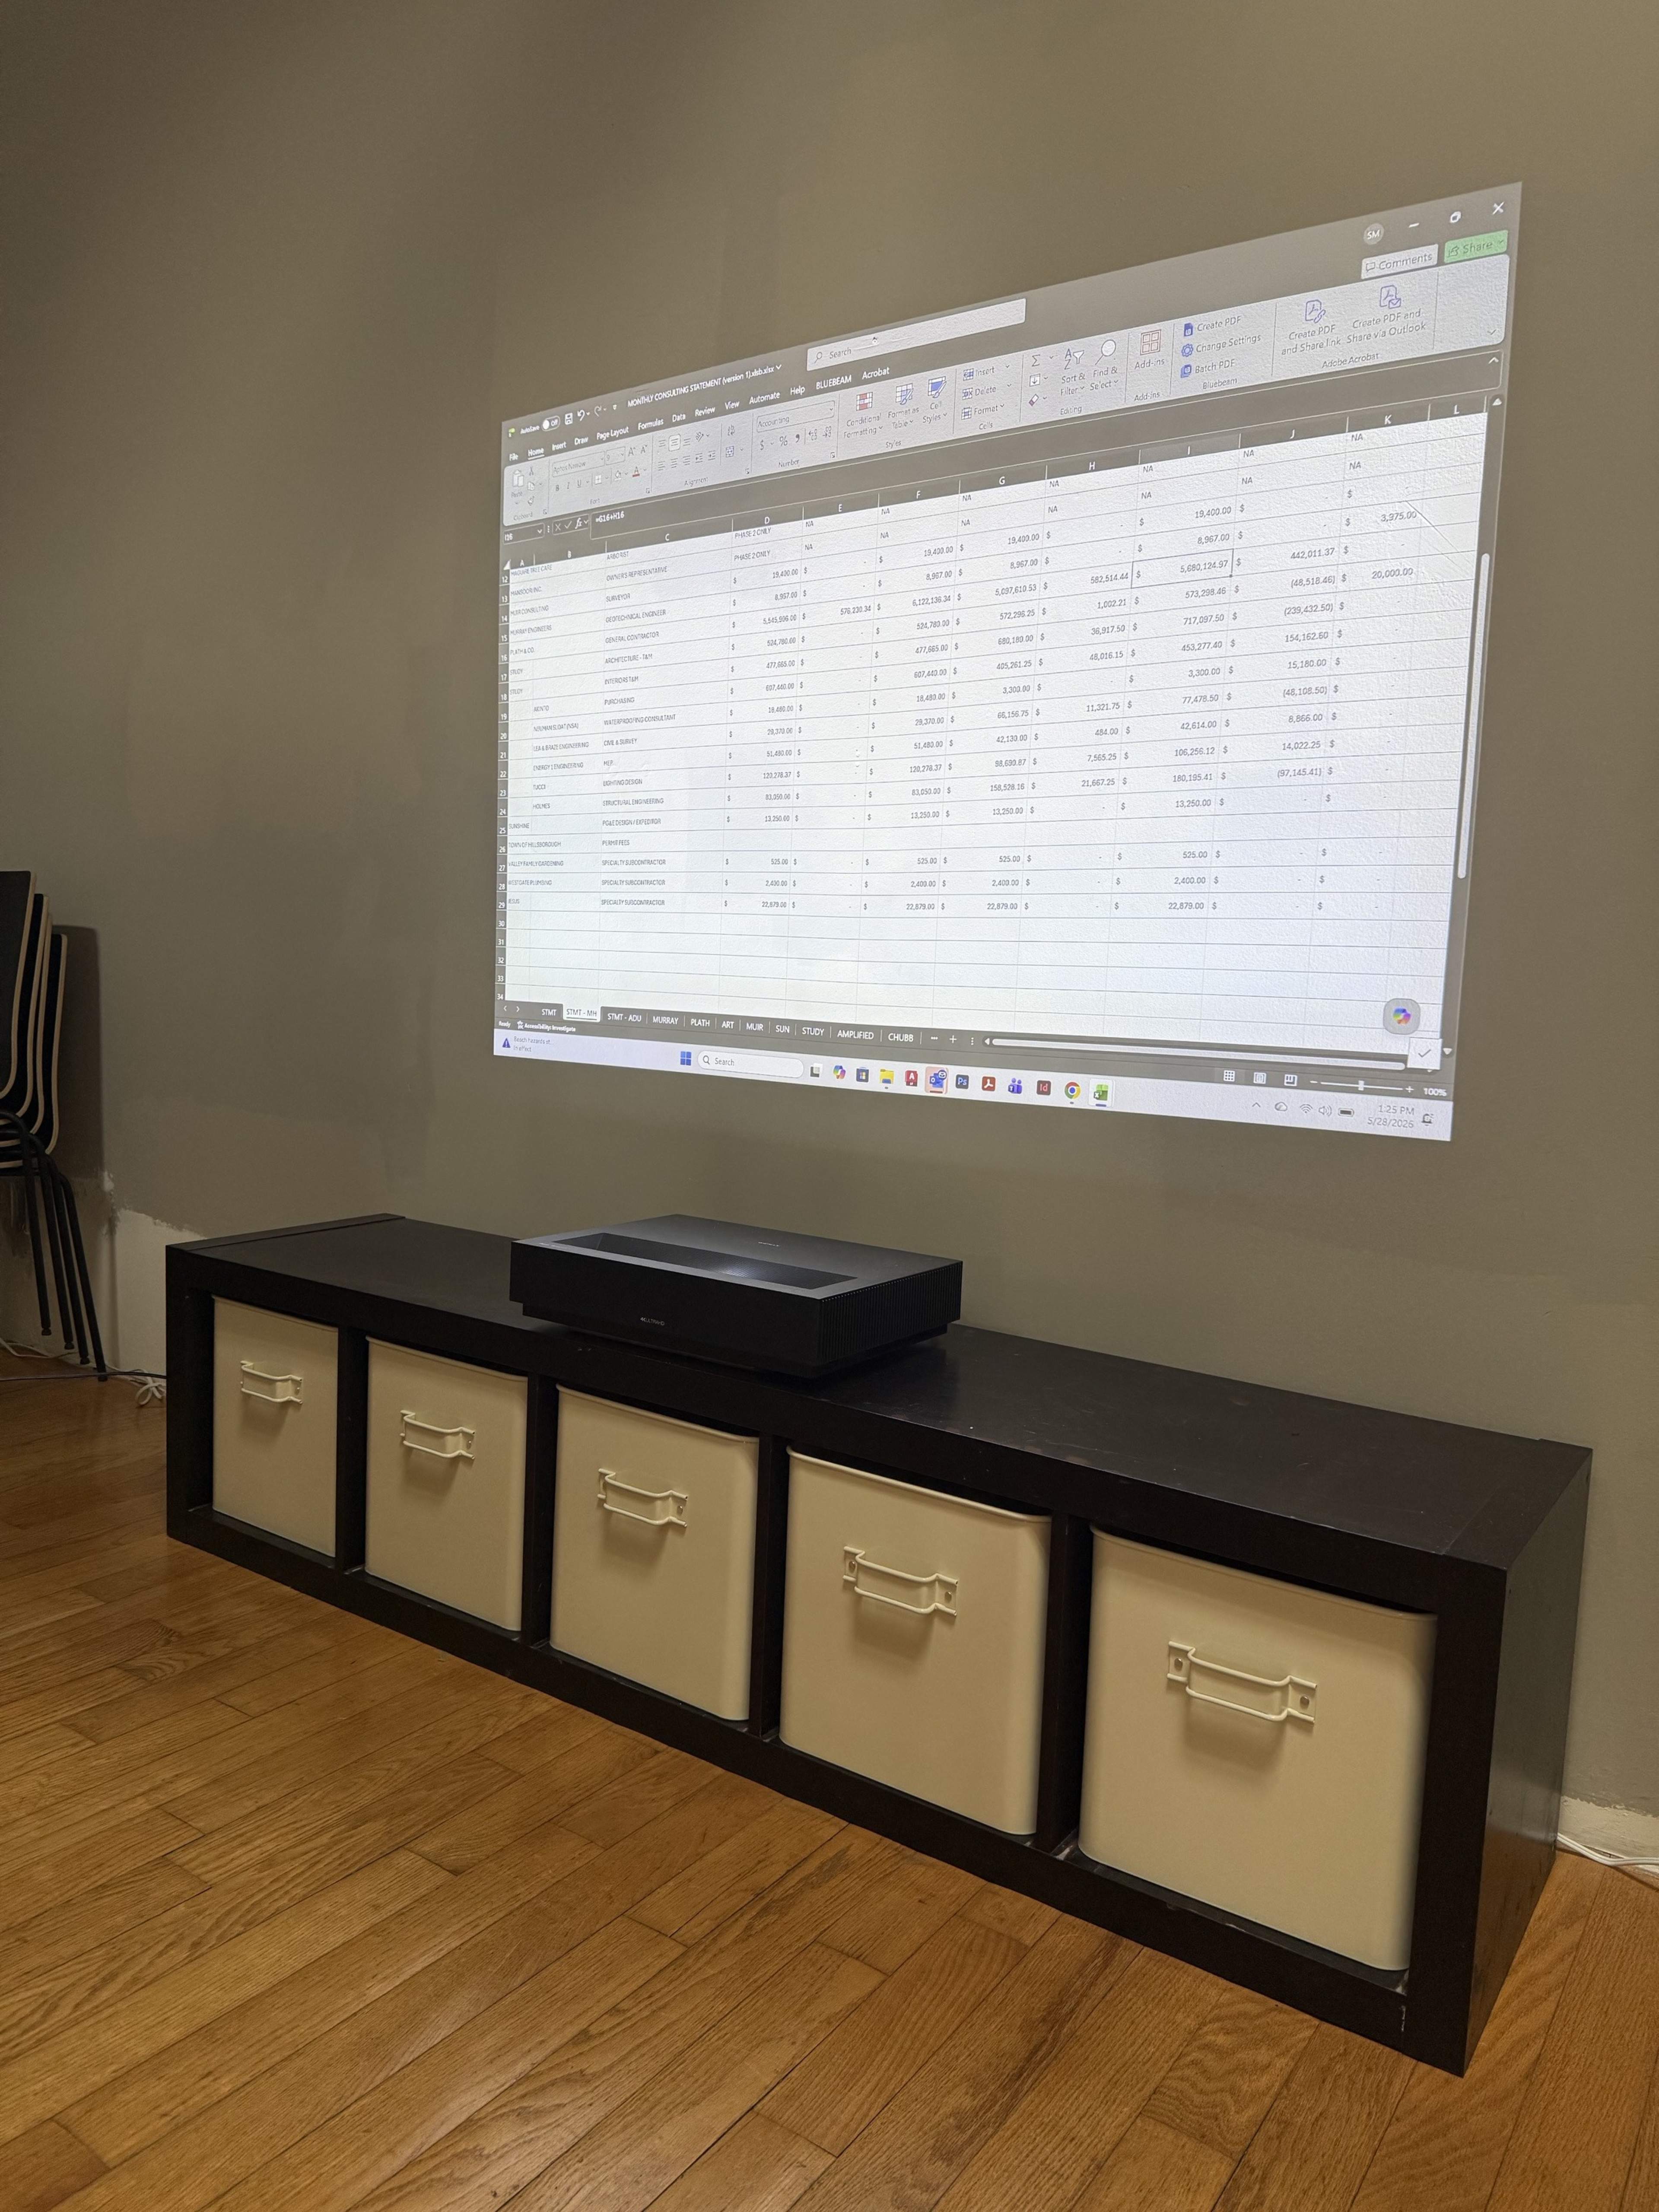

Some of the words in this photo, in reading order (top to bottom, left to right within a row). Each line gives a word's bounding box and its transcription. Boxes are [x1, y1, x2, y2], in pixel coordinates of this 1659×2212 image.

[1367, 230, 1380, 238] SM
[1463, 240, 1492, 253] Share
[1379, 253, 1433, 270] Comments
[1197, 320, 1222, 331] Create
[1225, 316, 1241, 326] PDF
[1352, 317, 1381, 329] Create
[1383, 313, 1401, 324] PDF
[1404, 309, 1421, 319] and
[1289, 327, 1316, 340] Create
[1318, 325, 1335, 335] PDF
[1347, 332, 1371, 344] Share
[1373, 330, 1386, 338] via
[1389, 322, 1426, 335] Outlook
[1196, 341, 1226, 353] Change
[1229, 334, 1261, 349] Settings
[1281, 346, 1297, 355] and
[1300, 342, 1324, 352] Share
[1326, 337, 1341, 347] link
[830, 348, 851, 359] Search
[1135, 358, 1164, 369] Add-ins
[1322, 358, 1347, 369] Adobe
[1348, 353, 1379, 365] Acrobat
[976, 367, 995, 376] Insert
[1195, 363, 1215, 374] Batch
[1217, 359, 1235, 369] PDF
[862, 367, 890, 379] Acrobat
[1093, 369, 1109, 377] Find
[817, 375, 852, 389] BLUEBEAM
[1062, 375, 1077, 384] Sort
[1203, 377, 1237, 389] Bluebeam
[628, 394, 653, 407] MONTHLY
[655, 385, 689, 401] CONSULTING
[690, 378, 721, 392] STATEMENT
[723, 372, 744, 386] (version
[791, 386, 805, 395] Help
[1090, 380, 1111, 391] Select
[975, 386, 996, 396] Delete
[1061, 386, 1078, 396] Filter
[1135, 391, 1160, 401] Add-ins
[749, 391, 780, 405] Automate
[725, 400, 739, 410] View
[974, 404, 998, 415] Format
[1060, 405, 1082, 415] Editing
[695, 406, 715, 416] Review
[888, 409, 910, 418] Format
[673, 413, 686, 422] Data
[758, 416, 789, 427] Accounting
[847, 414, 881, 426] Conditional
[923, 413, 941, 423] Styles
[638, 418, 663, 430] Formulas
[892, 420, 907, 428] Table
[521, 426, 539, 434] AutoSave
[597, 431, 610, 441] Page
[610, 426, 629, 437] Layout
[844, 427, 877, 439] Formatting
[552, 441, 566, 450] Insert
[575, 436, 588, 445] Draw
[886, 440, 901, 448] Styles
[779, 459, 799, 467] Number
[1350, 461, 1361, 470] NA
[595, 511, 624, 522] =G16+H16
[1195, 506, 1231, 519] 19,400.00
[1008, 534, 1039, 545] 19,400.00
[1198, 534, 1230, 545] 8,967.00
[1291, 547, 1335, 559] 442,011.37
[1010, 559, 1038, 570] 8,967.00
[1180, 560, 1228, 574] 5,680,124.97
[628, 566, 667, 578] REPRESENTATIVE
[1372, 568, 1413, 579] 20,000.00
[1091, 572, 1128, 584] 582,514.44
[1291, 575, 1335, 588] (48,518.46)
[995, 584, 1036, 596] 5,097,610.53
[1185, 587, 1226, 599] 573,298.46
[606, 593, 630, 602] SURVEYOR
[1097, 599, 1126, 609] 1,002.21
[1284, 603, 1333, 616] (239,432.50)
[606, 612, 640, 623] GEOTECHNICAL
[642, 609, 666, 619] ENGINEER
[1184, 614, 1224, 626] 717,097.50
[1091, 625, 1125, 636] 36,917.50
[605, 635, 626, 644] GENERAL
[627, 631, 659, 642] CONTRACTOR
[998, 635, 1033, 645] 680,180.00
[1285, 632, 1328, 642] 154,162.60
[1181, 641, 1222, 652] 453,277.40
[1090, 651, 1123, 661] 48,016.15
[997, 660, 1032, 671] 405,261.25
[1287, 659, 1326, 670] 15,180.00
[1189, 667, 1220, 678] 3,300.00
[1003, 685, 1030, 694] 3,300.00
[1283, 686, 1327, 698] (48,108.50)
[1182, 694, 1219, 704] 77,478.50
[1087, 703, 1120, 712] 11,321.75
[998, 710, 1029, 719] 66,156.75
[1180, 720, 1217, 730] 42,614.00
[1095, 728, 1118, 737] 484.00
[996, 734, 1027, 744] 42,130.00
[1282, 741, 1321, 751] 14,022.25
[1175, 747, 1215, 757] 106,256.12
[1087, 753, 1116, 762] 7,565.25
[1278, 768, 1321, 778] (97,145.41)
[1082, 779, 1115, 787] 21,667.25
[1173, 774, 1213, 783] 180,195.41
[990, 783, 1024, 792] 158,528.16
[1176, 799, 1211, 808] 13,250.00
[993, 807, 1023, 816] 13,250.00
[1174, 877, 1205, 885] 2,400.00
[1168, 902, 1204, 910] 22,879.00
[653, 1017, 678, 1025] MURRAY
[691, 1019, 710, 1027] PLATH
[722, 1020, 734, 1029] ART
[746, 1023, 763, 1031] MUIR
[775, 1025, 789, 1033] SUN
[802, 1027, 824, 1036] STUDY
[838, 1030, 874, 1039] AMPLIFIED
[888, 1033, 913, 1042] CHUBB
[715, 1057, 734, 1066] Search
[1423, 1087, 1447, 1096] 100%
[1379, 1105, 1397, 1115] 1:25
[1400, 1106, 1414, 1115] PM
[1367, 1116, 1413, 1128] 5/28/2026
